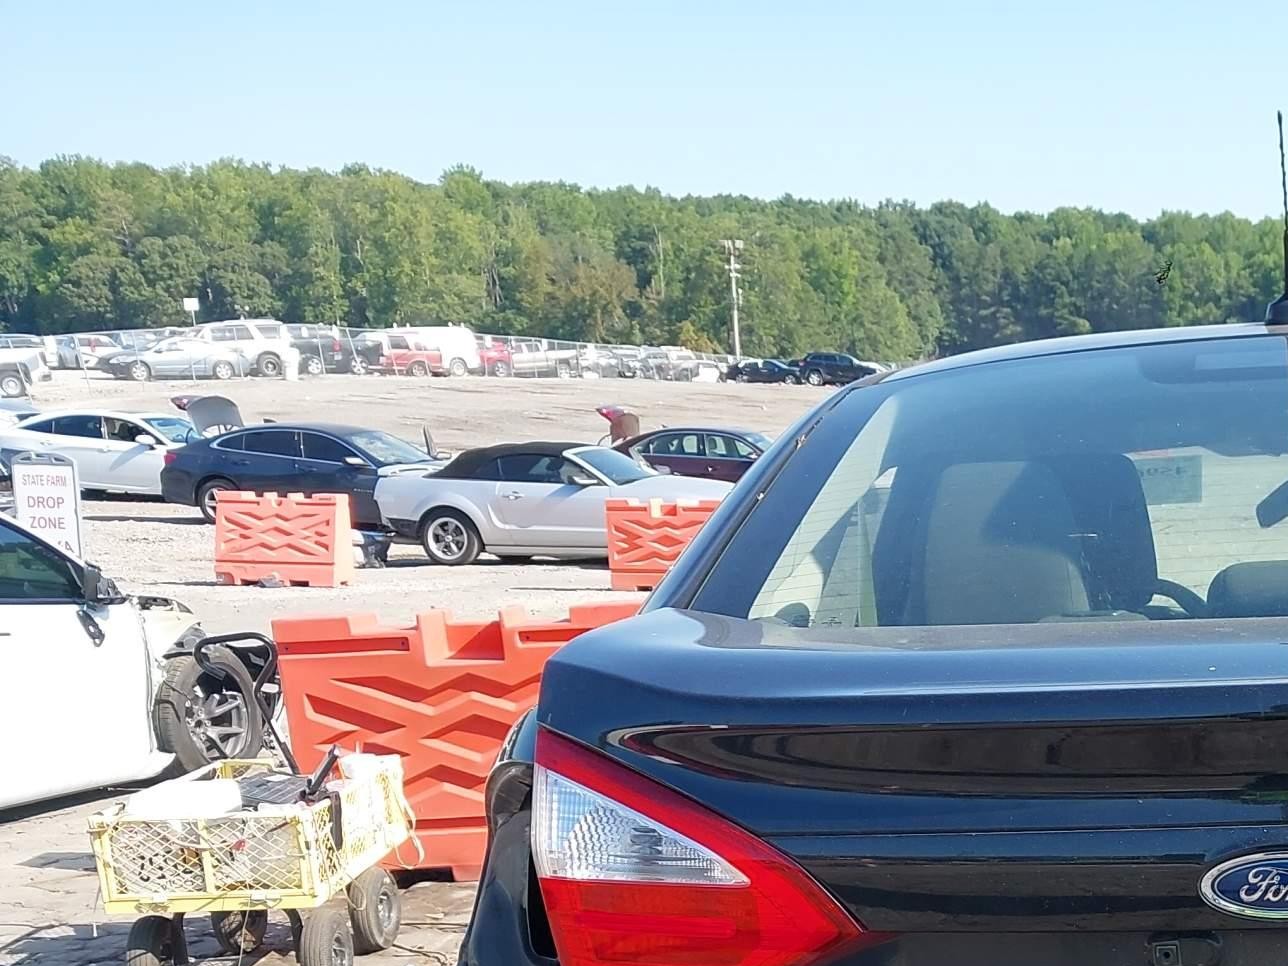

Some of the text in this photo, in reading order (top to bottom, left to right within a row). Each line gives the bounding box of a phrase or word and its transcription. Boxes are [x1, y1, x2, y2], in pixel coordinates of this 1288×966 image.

[22, 474, 66, 487] STATE FARM
[27, 496, 64, 509] DROP
[29, 516, 66, 529] ZONE
